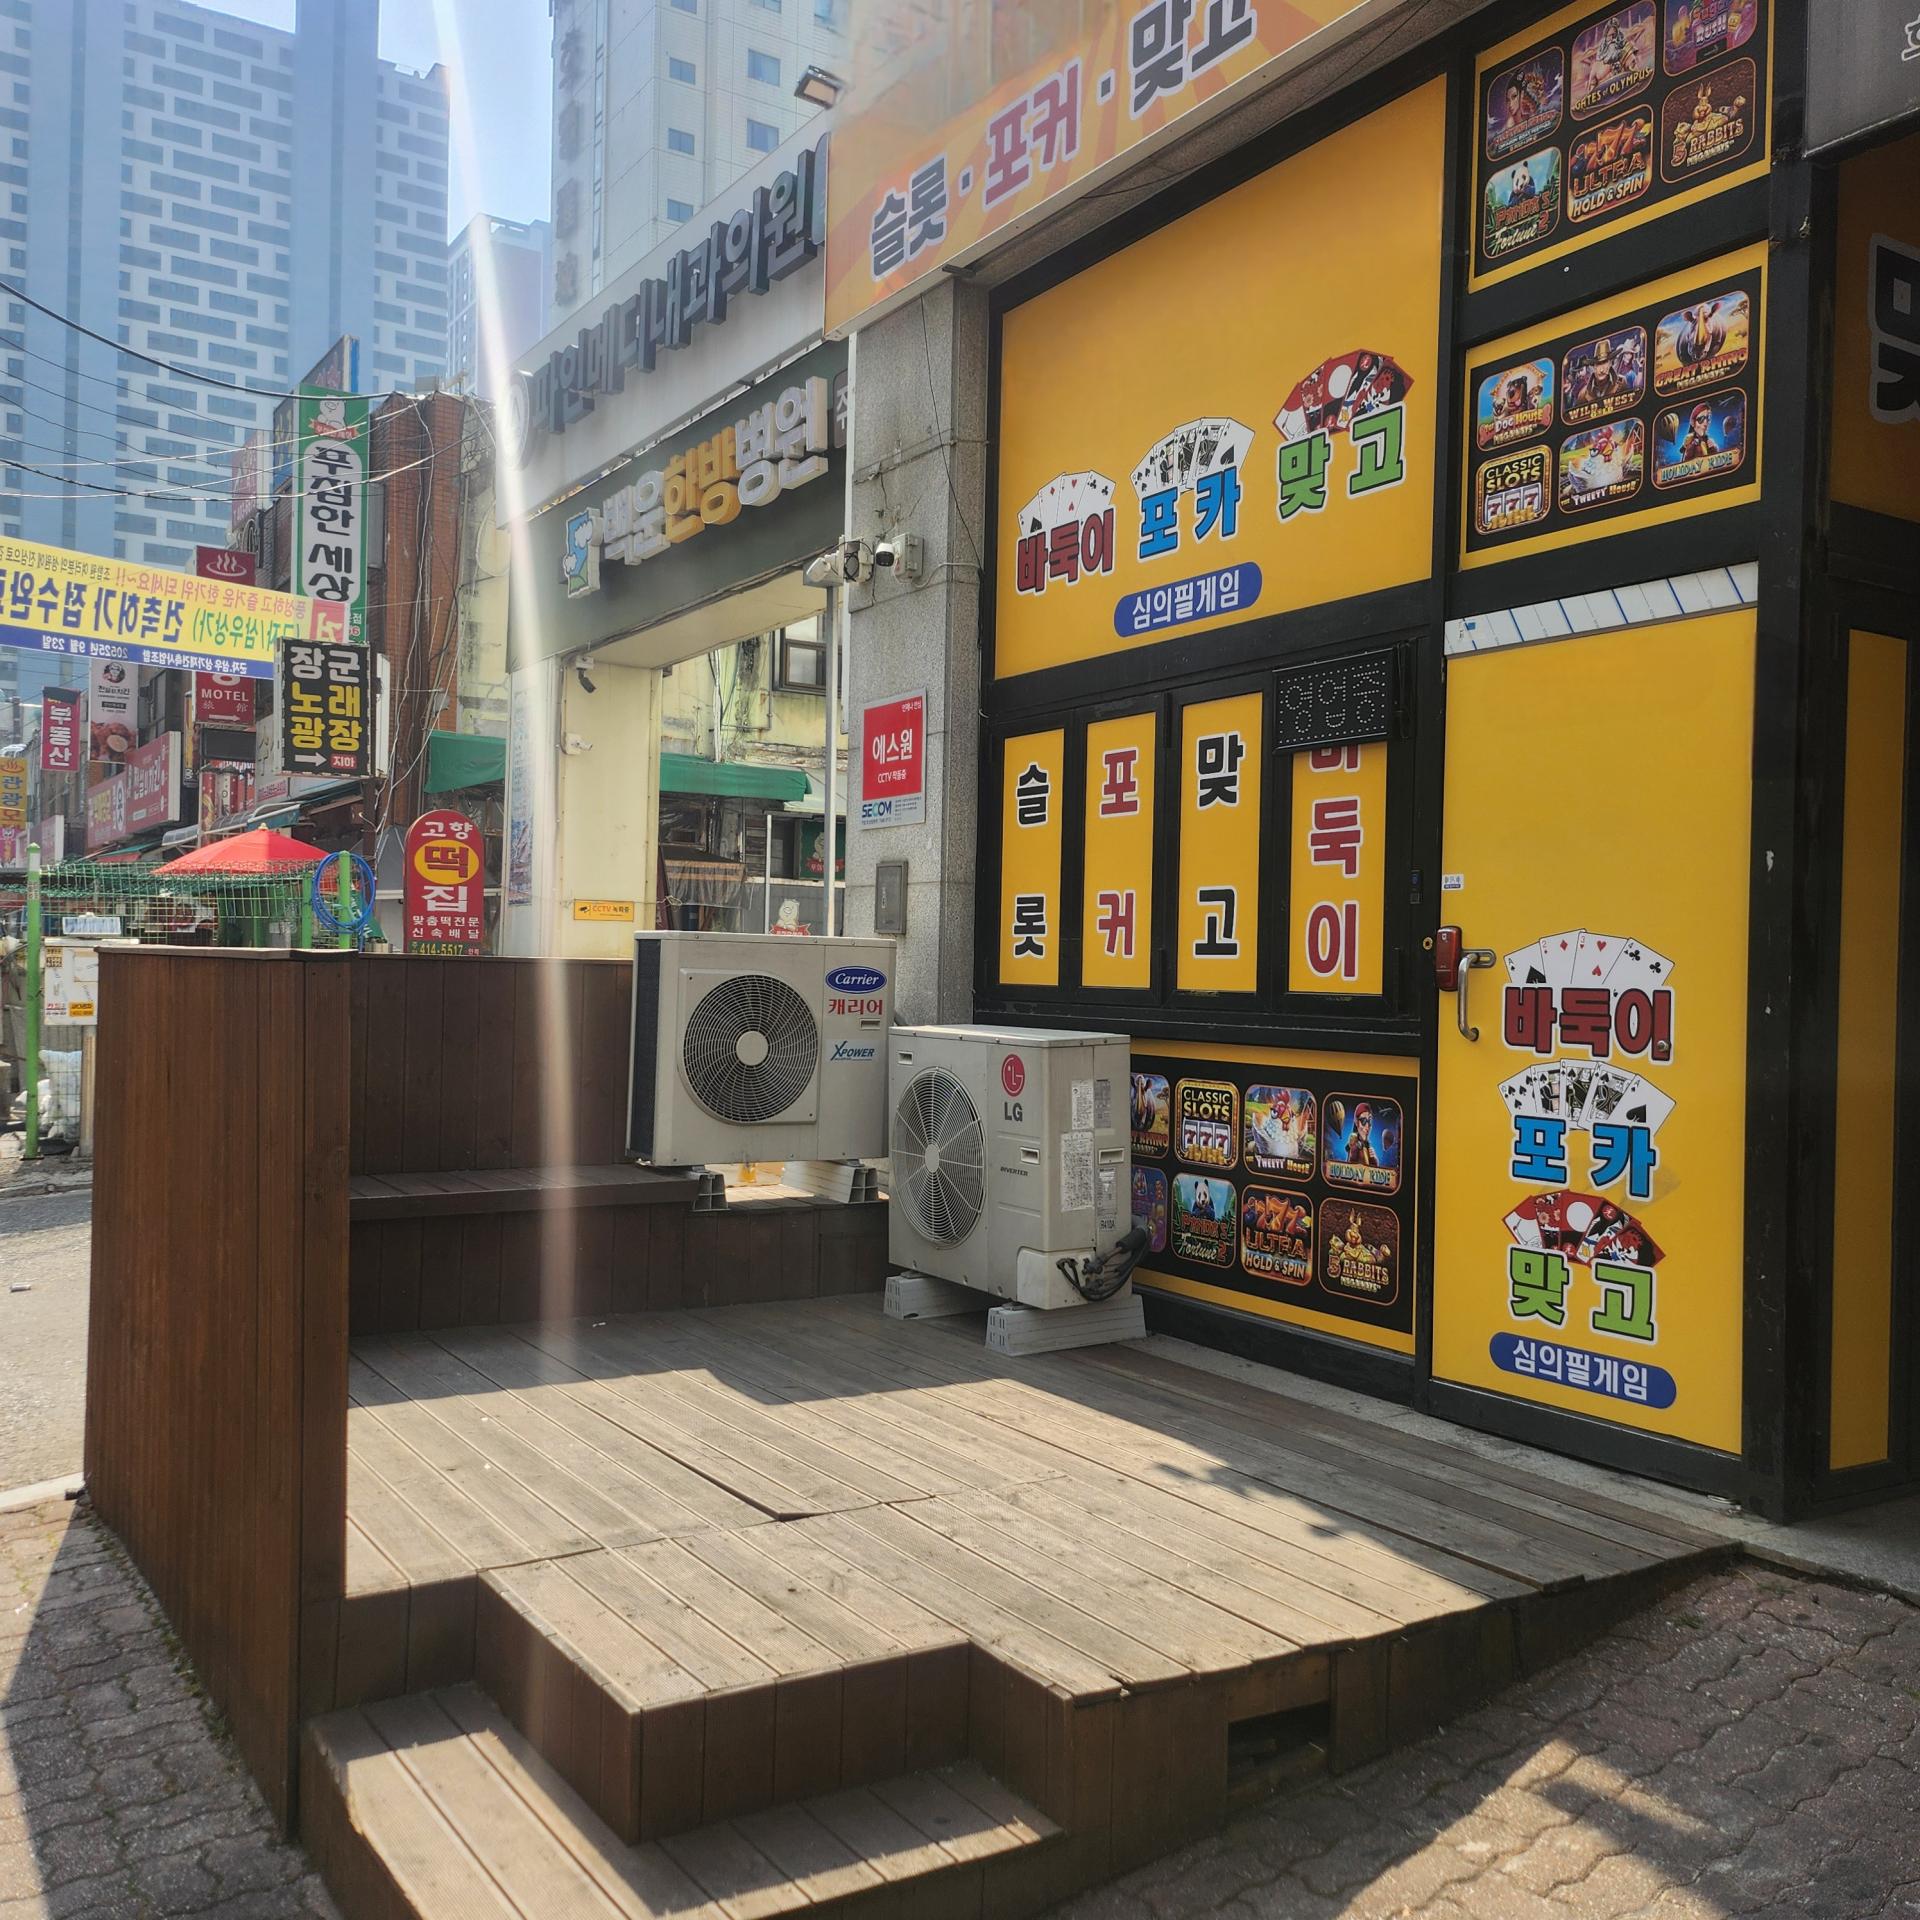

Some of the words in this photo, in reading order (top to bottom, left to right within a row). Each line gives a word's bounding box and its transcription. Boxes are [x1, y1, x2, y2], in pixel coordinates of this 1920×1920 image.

[1609, 69, 1651, 94] OLYMPUS
[1671, 142, 1687, 167] 5
[1690, 119, 1744, 153] RABBITS
[873, 157, 946, 278] 슬롯
[985, 61, 1080, 206] 포커
[1573, 152, 1646, 197] ULTRA
[1573, 192, 1604, 218] HOLD
[1607, 188, 1614, 200] &
[1616, 175, 1644, 199] SPIN
[1538, 210, 1550, 232] 2
[1700, 347, 1748, 374] RHINO
[1568, 402, 1598, 420] WILD
[1603, 392, 1636, 408] WEST
[602, 376, 829, 566] 백운한방병원
[1486, 455, 1542, 479] CLASSIC
[1486, 467, 1541, 493] SLOTS
[1661, 460, 1703, 481] HOLIDAY
[1708, 453, 1733, 470] RIDE
[309, 446, 355, 536] 푸짐한
[1017, 508, 1115, 593] 바둑이
[309, 543, 355, 603] 세상
[1132, 570, 1241, 631] 심의필게임
[290, 646, 360, 683] 장군
[201, 689, 249, 702] MOTEL
[290, 682, 361, 717] 노래
[1285, 669, 1385, 733] 영업중
[49, 706, 73, 767] 부동산
[290, 717, 362, 752] 광장
[872, 728, 913, 764] 에스원
[877, 771, 892, 784] CCTV
[861, 801, 892, 818] SECOM
[421, 821, 474, 840] 고향
[1194, 733, 1244, 956] 맞고
[424, 845, 469, 879] 떡
[1014, 763, 1050, 957] 슬롯
[1098, 749, 1138, 956] 포커
[422, 885, 468, 912] 집
[592, 905, 612, 913] CCTV
[412, 915, 480, 928] 맞춤떡전문
[412, 928, 480, 940] 신속배달
[835, 972, 880, 985] Carrier
[828, 999, 883, 1016] 캐리어
[1505, 987, 1672, 1061] 바둑이
[1183, 1089, 1231, 1105] CLASSIC
[1183, 1101, 1230, 1121] SLOTS
[1004, 1102, 1023, 1122] LG
[1000, 1166, 1028, 1177] INVERTER
[1329, 1164, 1366, 1182] HOLIDAY
[1369, 1170, 1391, 1186] RIDE
[1218, 1240, 1227, 1261] 2
[1245, 1226, 1307, 1260] ULTRA
[1246, 1251, 1272, 1272] HOLD
[1274, 1260, 1280, 1272] &
[1282, 1260, 1306, 1279] SPIN
[1327, 1254, 1341, 1278] 5
[1343, 1259, 1390, 1286] RABBITS
[1513, 1340, 1649, 1402] 심의필게임
